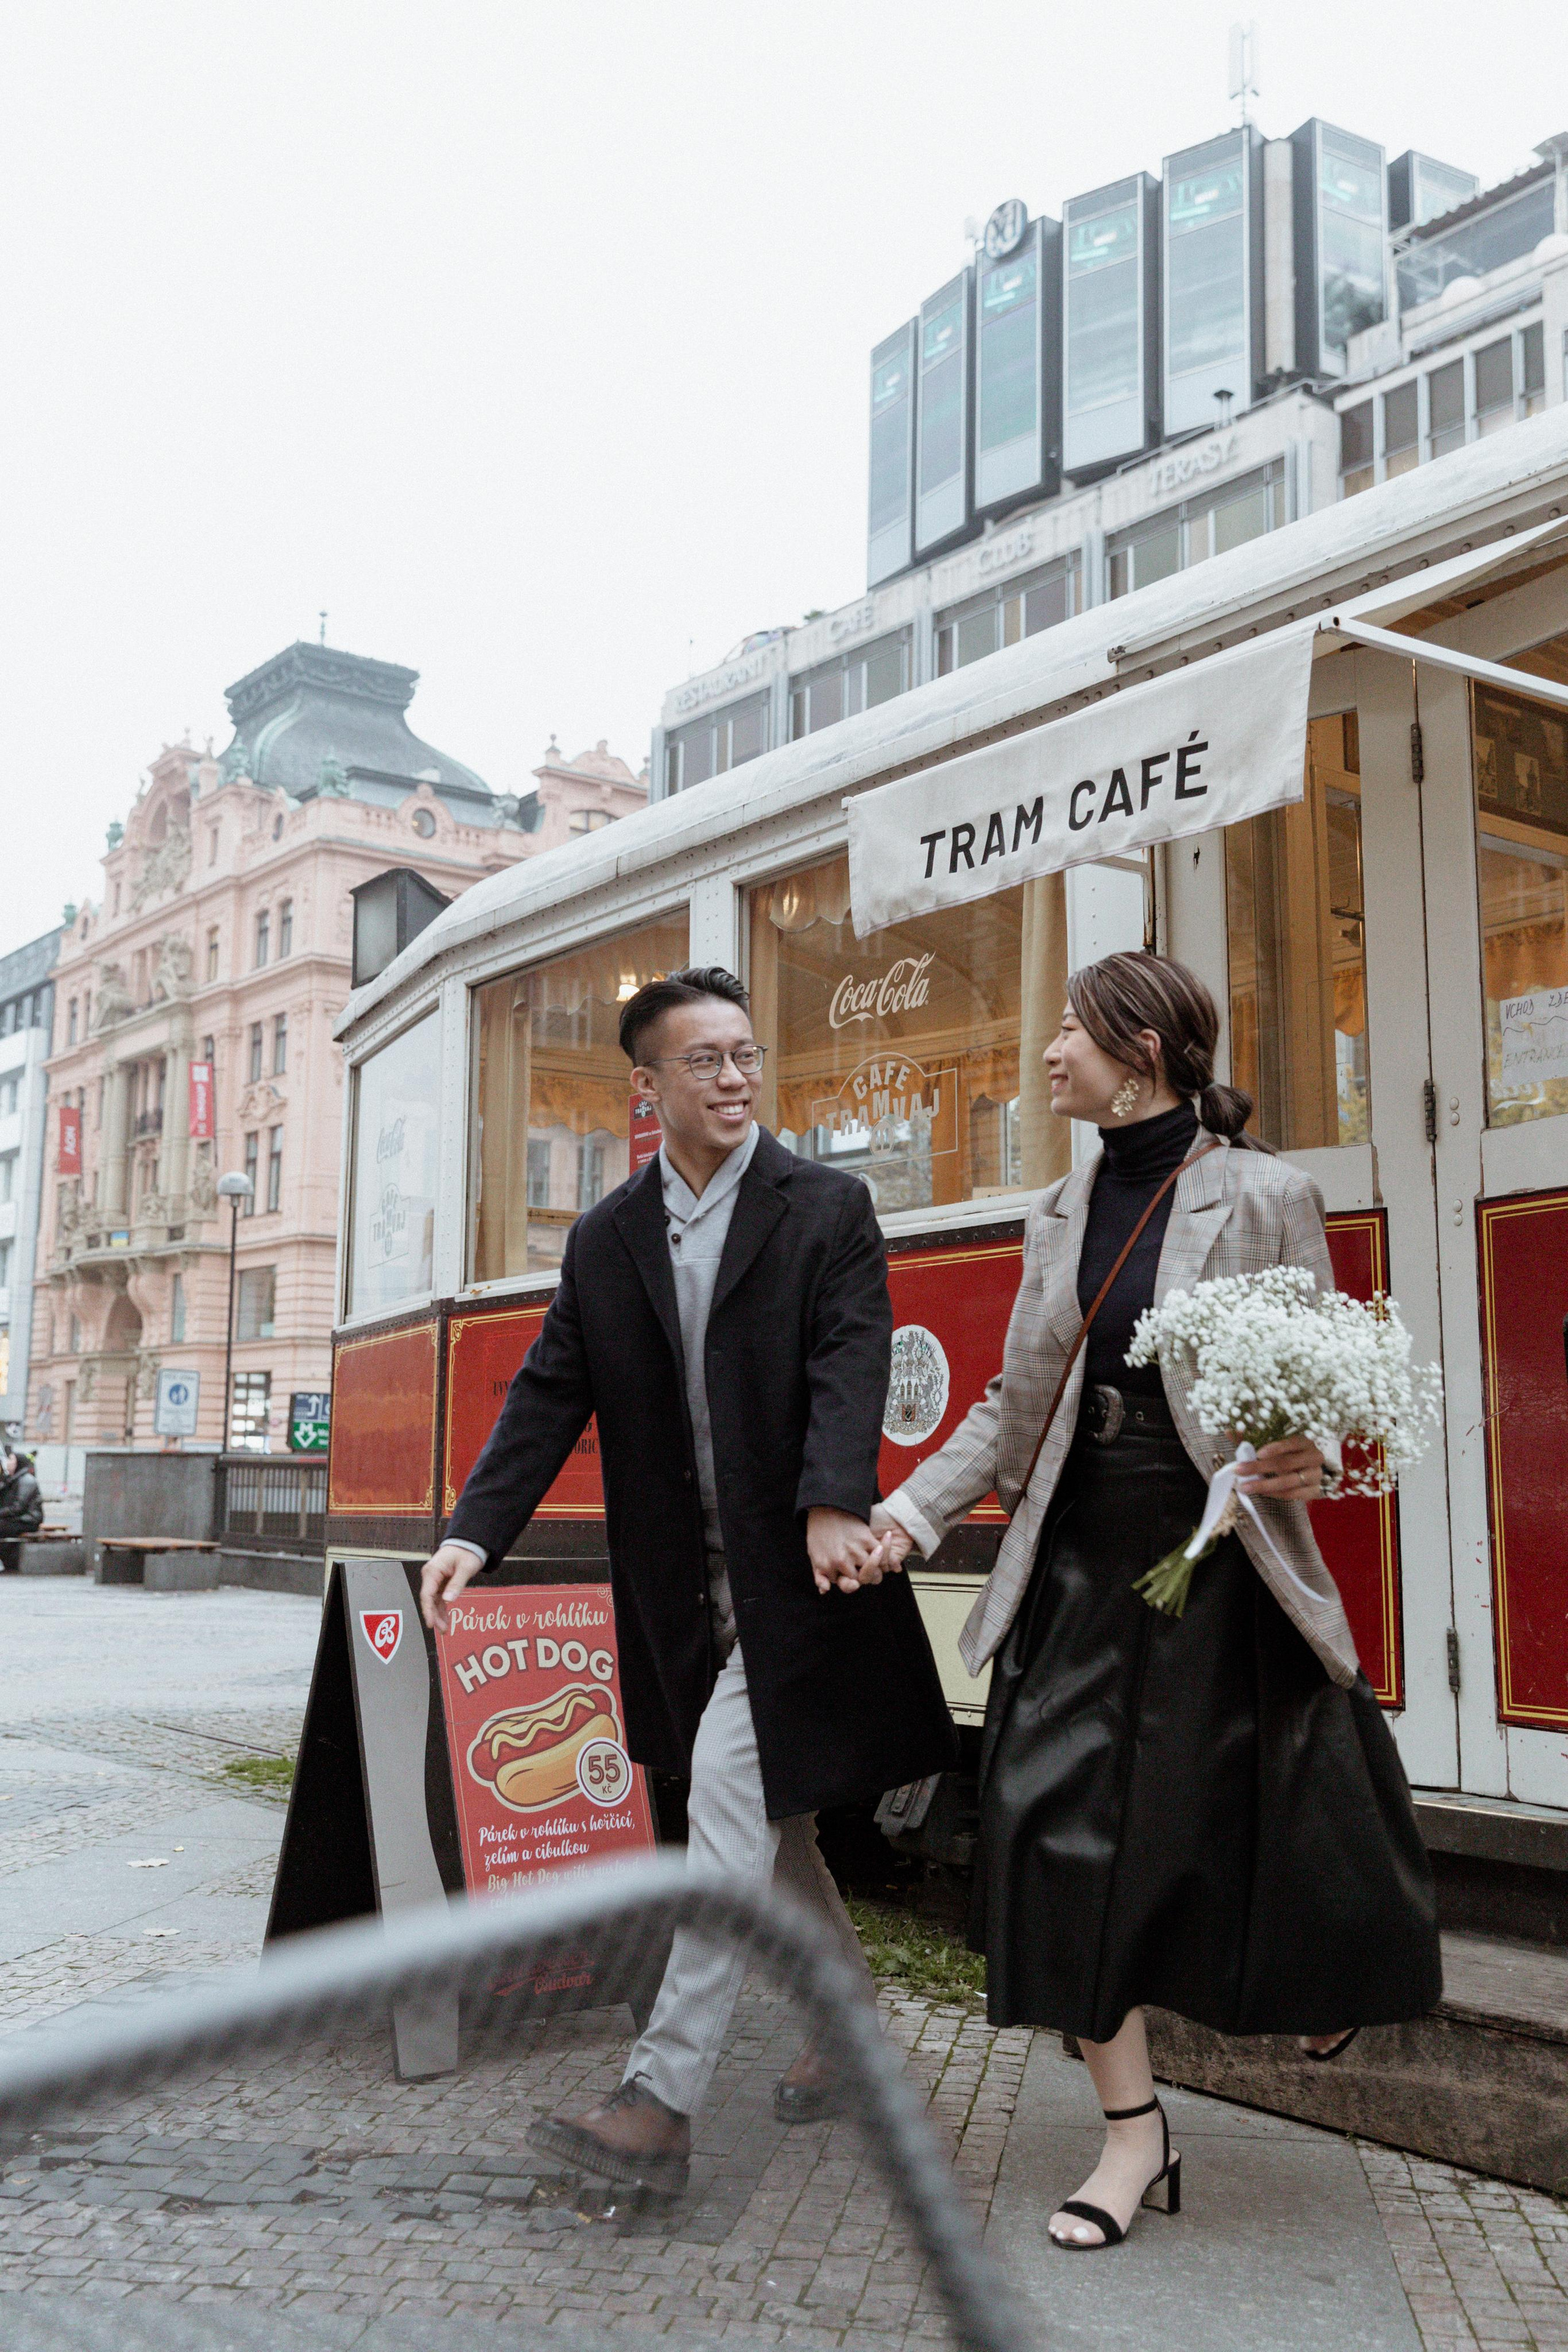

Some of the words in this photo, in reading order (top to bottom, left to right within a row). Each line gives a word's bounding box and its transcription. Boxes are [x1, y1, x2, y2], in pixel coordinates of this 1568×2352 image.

[920, 796, 1044, 880] TRAM
[1068, 729, 1209, 831] CAFÉ
[829, 951, 937, 1029] Coca-Cola
[853, 1061, 911, 1100] CAFE
[826, 1088, 940, 1140] TRAMVAJ
[448, 1605, 511, 1637] Párek
[516, 1613, 530, 1629] v
[533, 1602, 609, 1630] rohlíku
[454, 1638, 529, 1694] HOT
[536, 1638, 614, 1681] DOG
[588, 1754, 621, 1785] 55
[478, 1823, 518, 1847] Párek
[520, 1827, 529, 1839] v
[530, 1817, 579, 1839] rohlíku
[581, 1820, 587, 1833] s
[590, 1810, 635, 1831] hořčicí,
[484, 1845, 519, 1872] zelím
[522, 1849, 532, 1861] a
[535, 1839, 590, 1860] cibulkou
[488, 1874, 510, 1894] Big
[513, 1870, 535, 1888] Hot
[537, 1868, 560, 1885] Dog
